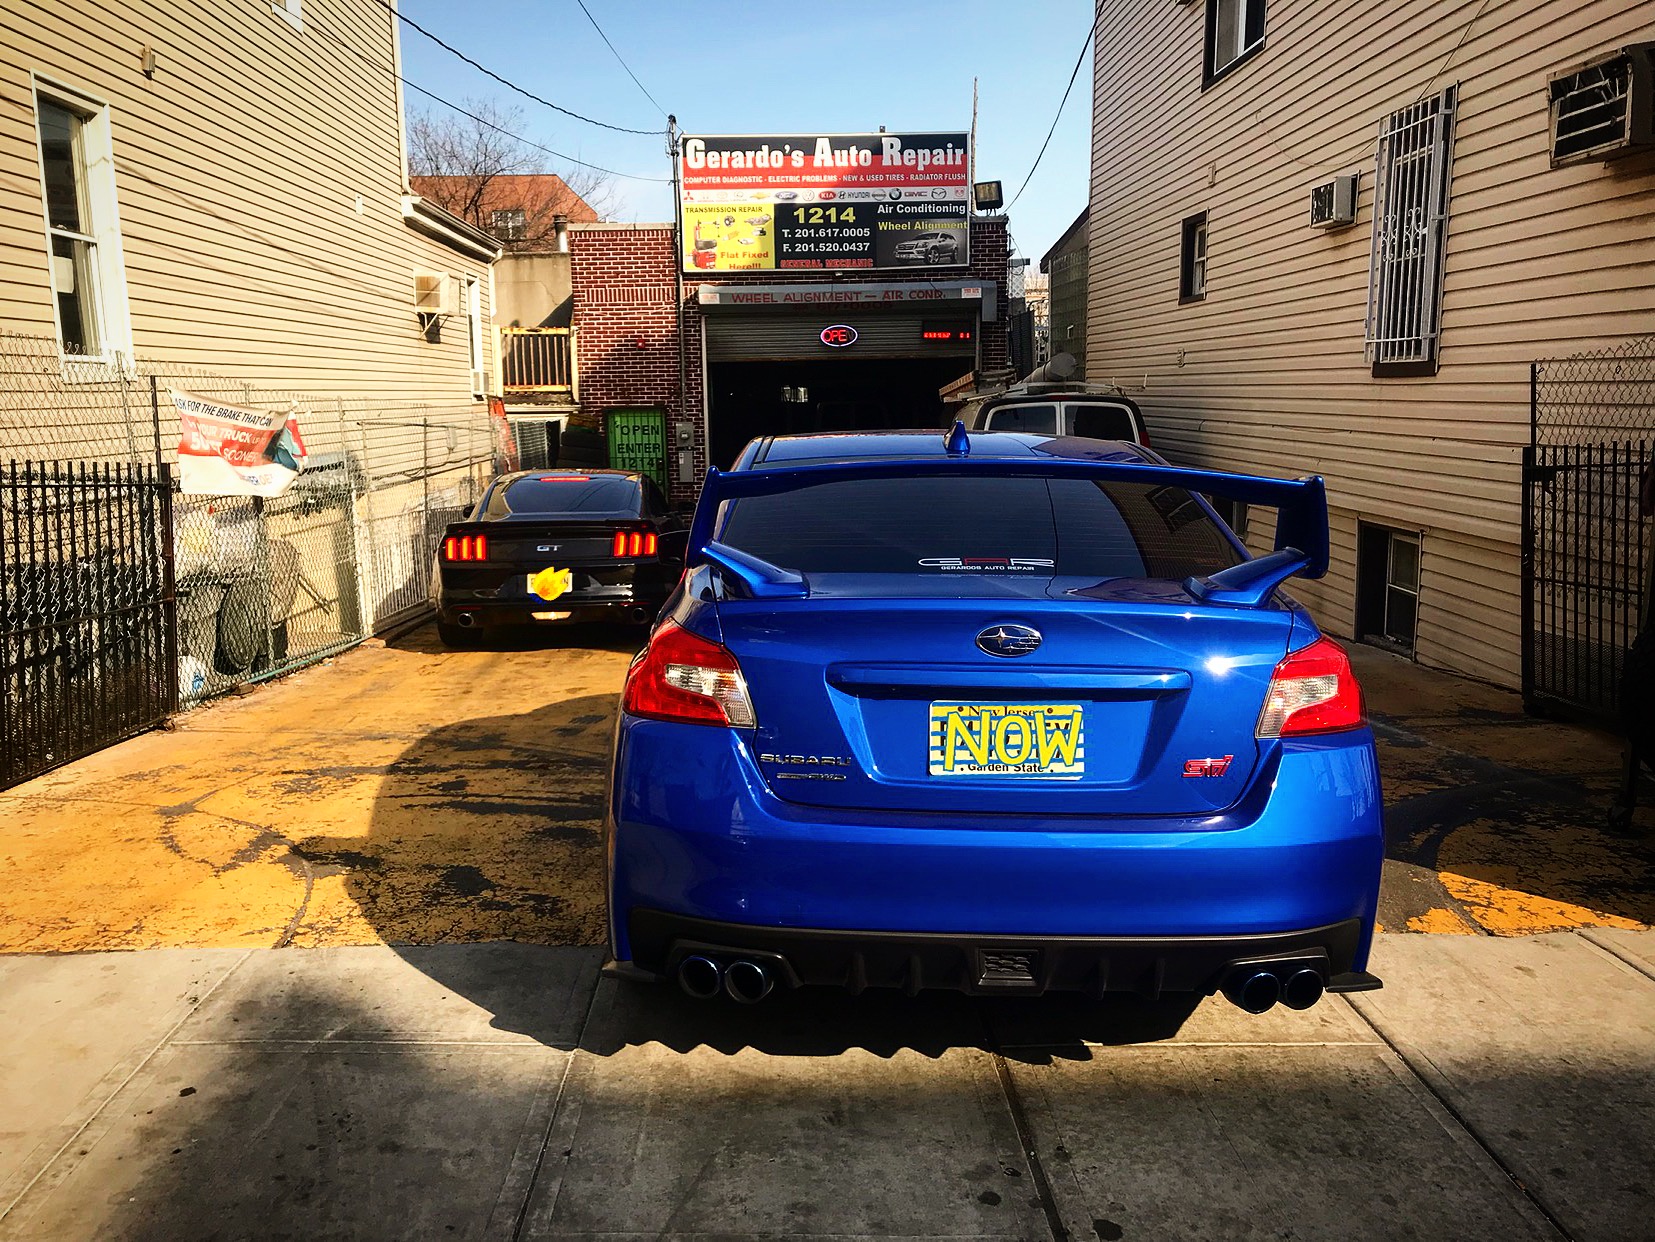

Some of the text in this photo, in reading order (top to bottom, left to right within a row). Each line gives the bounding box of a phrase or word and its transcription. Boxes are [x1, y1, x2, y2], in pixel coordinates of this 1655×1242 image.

[686, 137, 964, 171] Gerardo's Auto Repair
[768, 175, 801, 183] ELECTRIC
[802, 174, 838, 182] PROBLEMS
[877, 203, 966, 214] Air Conditioning
[793, 207, 856, 224] 1214
[878, 220, 968, 231] Wheel Alignment
[782, 228, 871, 238] T. 201.617.0005
[783, 242, 871, 252] F. 201.520.0437
[720, 251, 769, 259] Flat Fixed
[731, 293, 779, 303] WHEEL
[783, 291, 863, 302] ALIGNMENT
[882, 290, 904, 300] AIR
[908, 289, 947, 300] COND.
[187, 400, 201, 412] FOR
[201, 403, 218, 416] THE
[216, 407, 242, 421] BRAKE
[240, 413, 261, 426] THAT
[219, 427, 252, 443] TRUCK
[620, 424, 660, 436] OPEN
[617, 443, 661, 454] ENTER
[622, 458, 655, 468] 1214
[537, 544, 563, 552] GT
[760, 753, 852, 766] SUBARU
[968, 763, 1044, 773] Garden State
